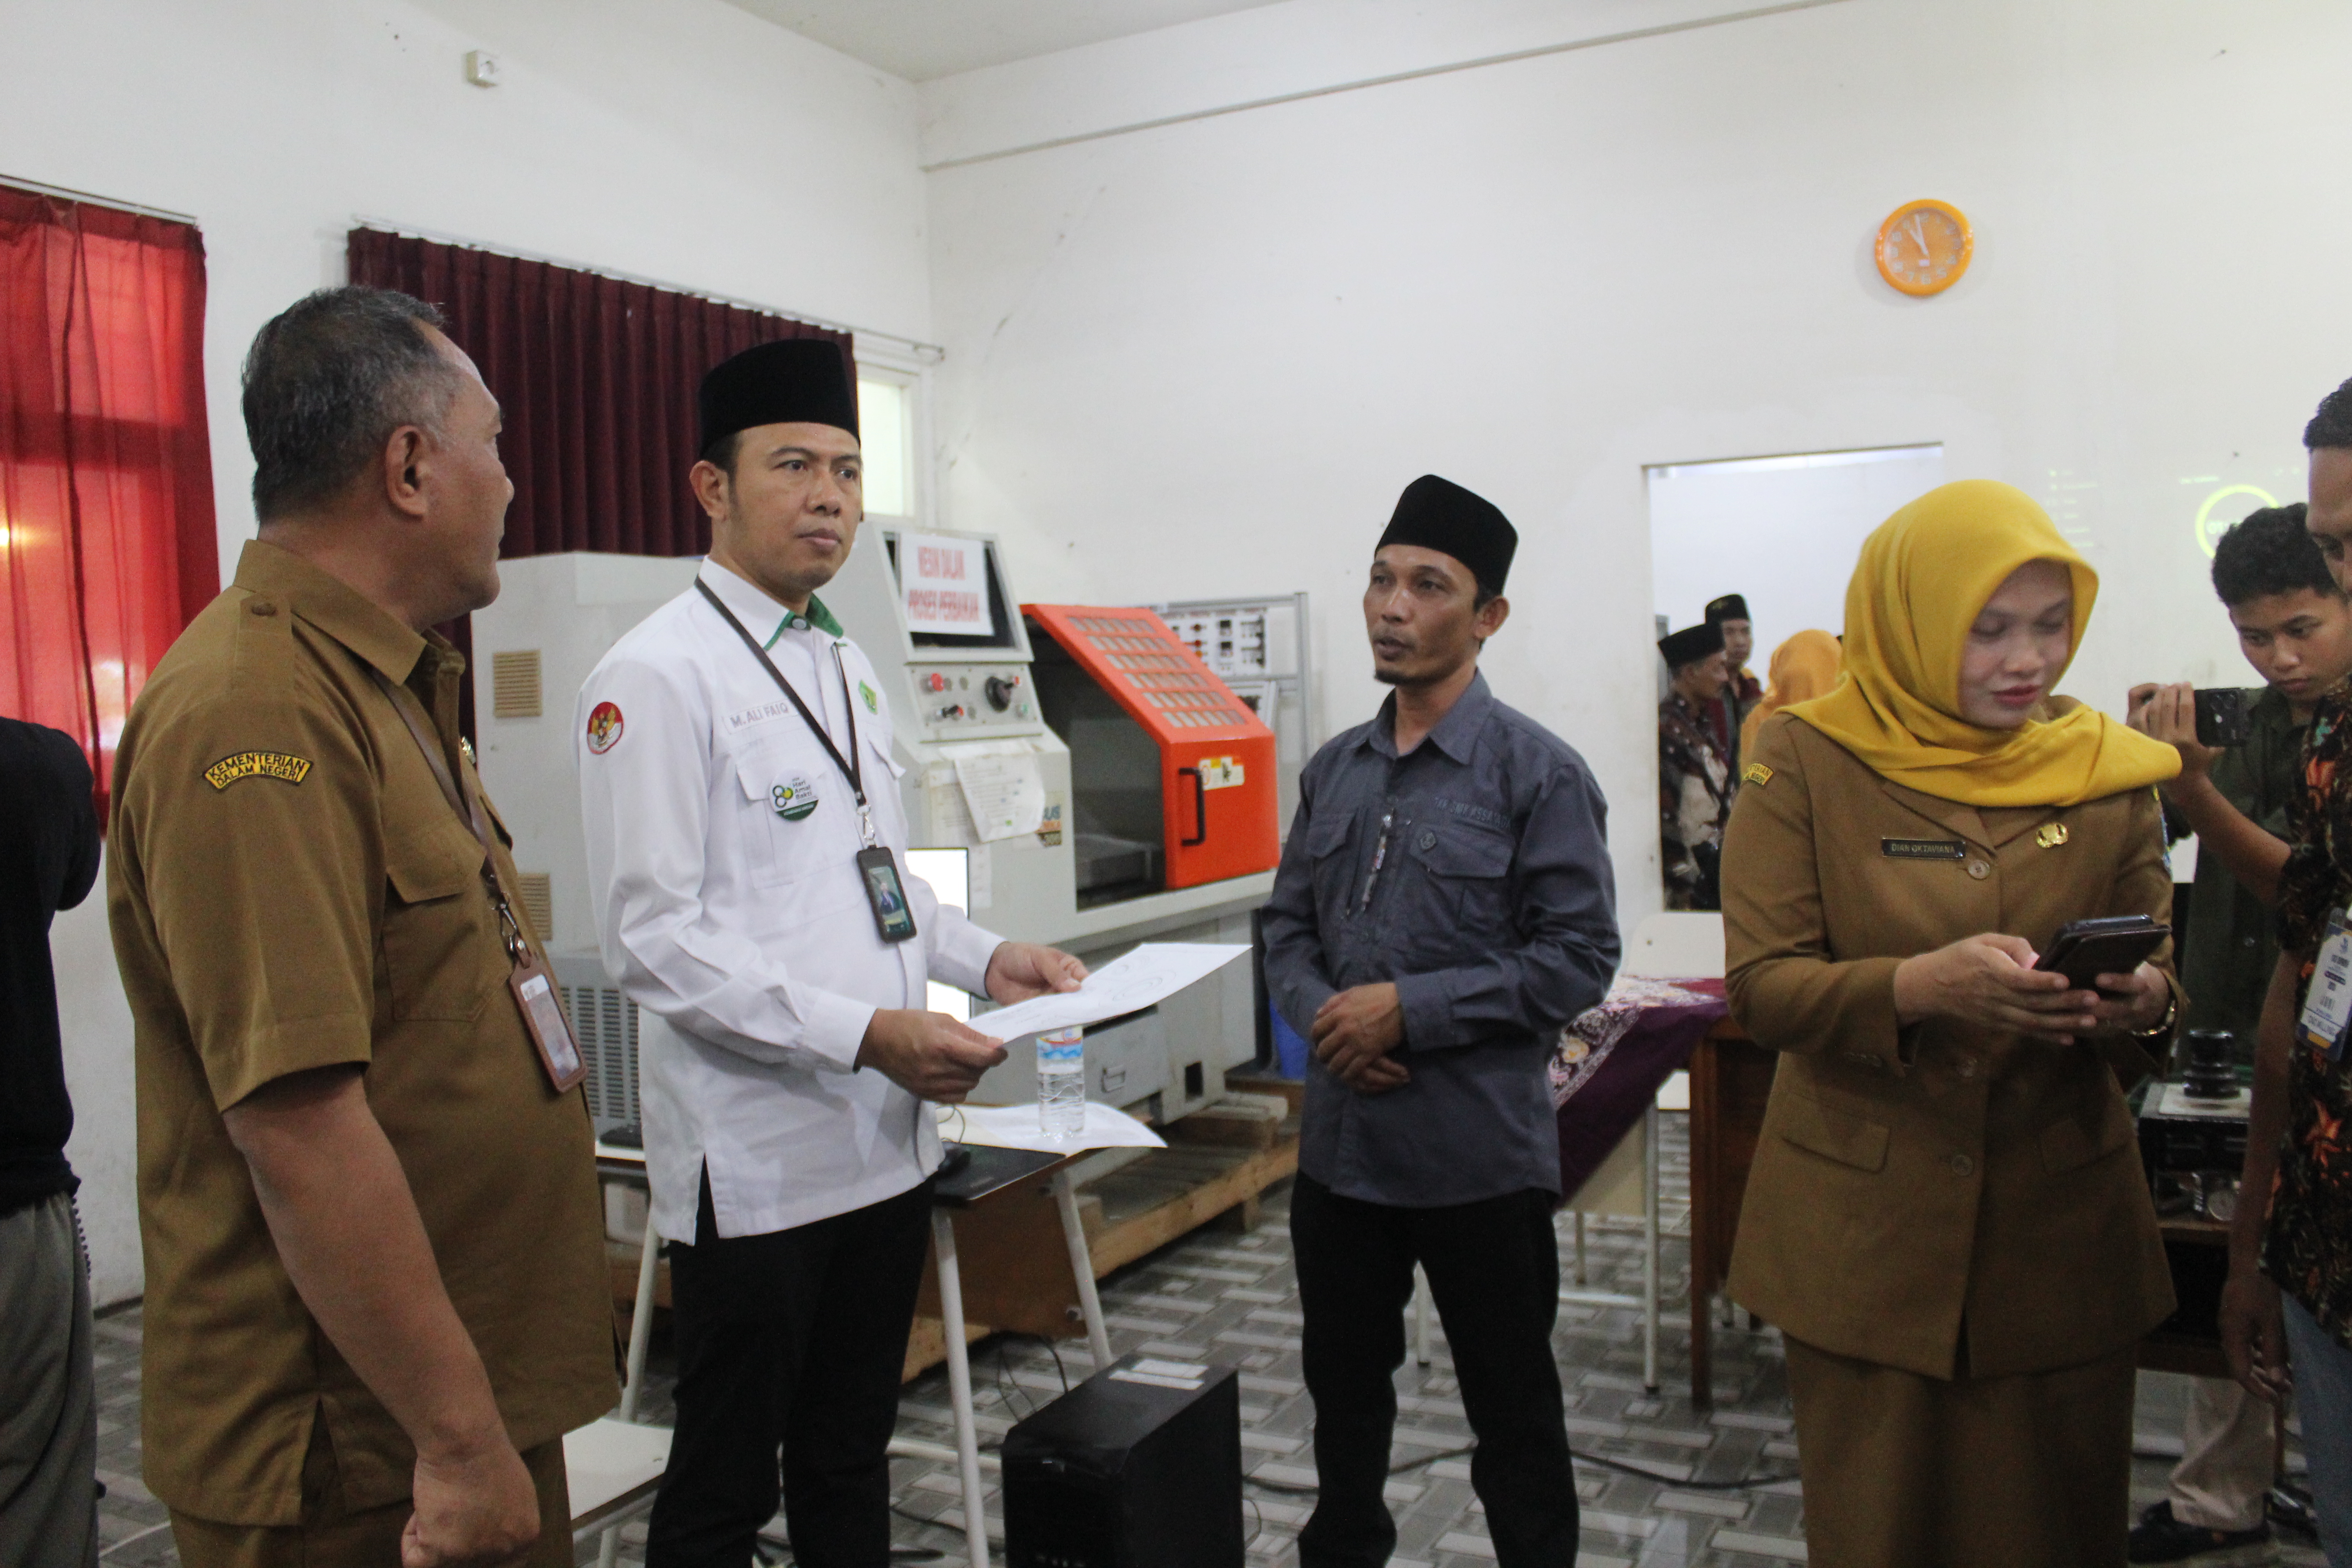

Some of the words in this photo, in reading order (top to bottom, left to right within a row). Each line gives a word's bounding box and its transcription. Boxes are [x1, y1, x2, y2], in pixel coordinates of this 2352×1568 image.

[208, 753, 305, 777] KEMENTERIAN
[260, 763, 300, 782] NEGERI
[795, 784, 811, 793] Amal
[796, 790, 812, 799] Bakti
[1891, 843, 1910, 852] DIAN
